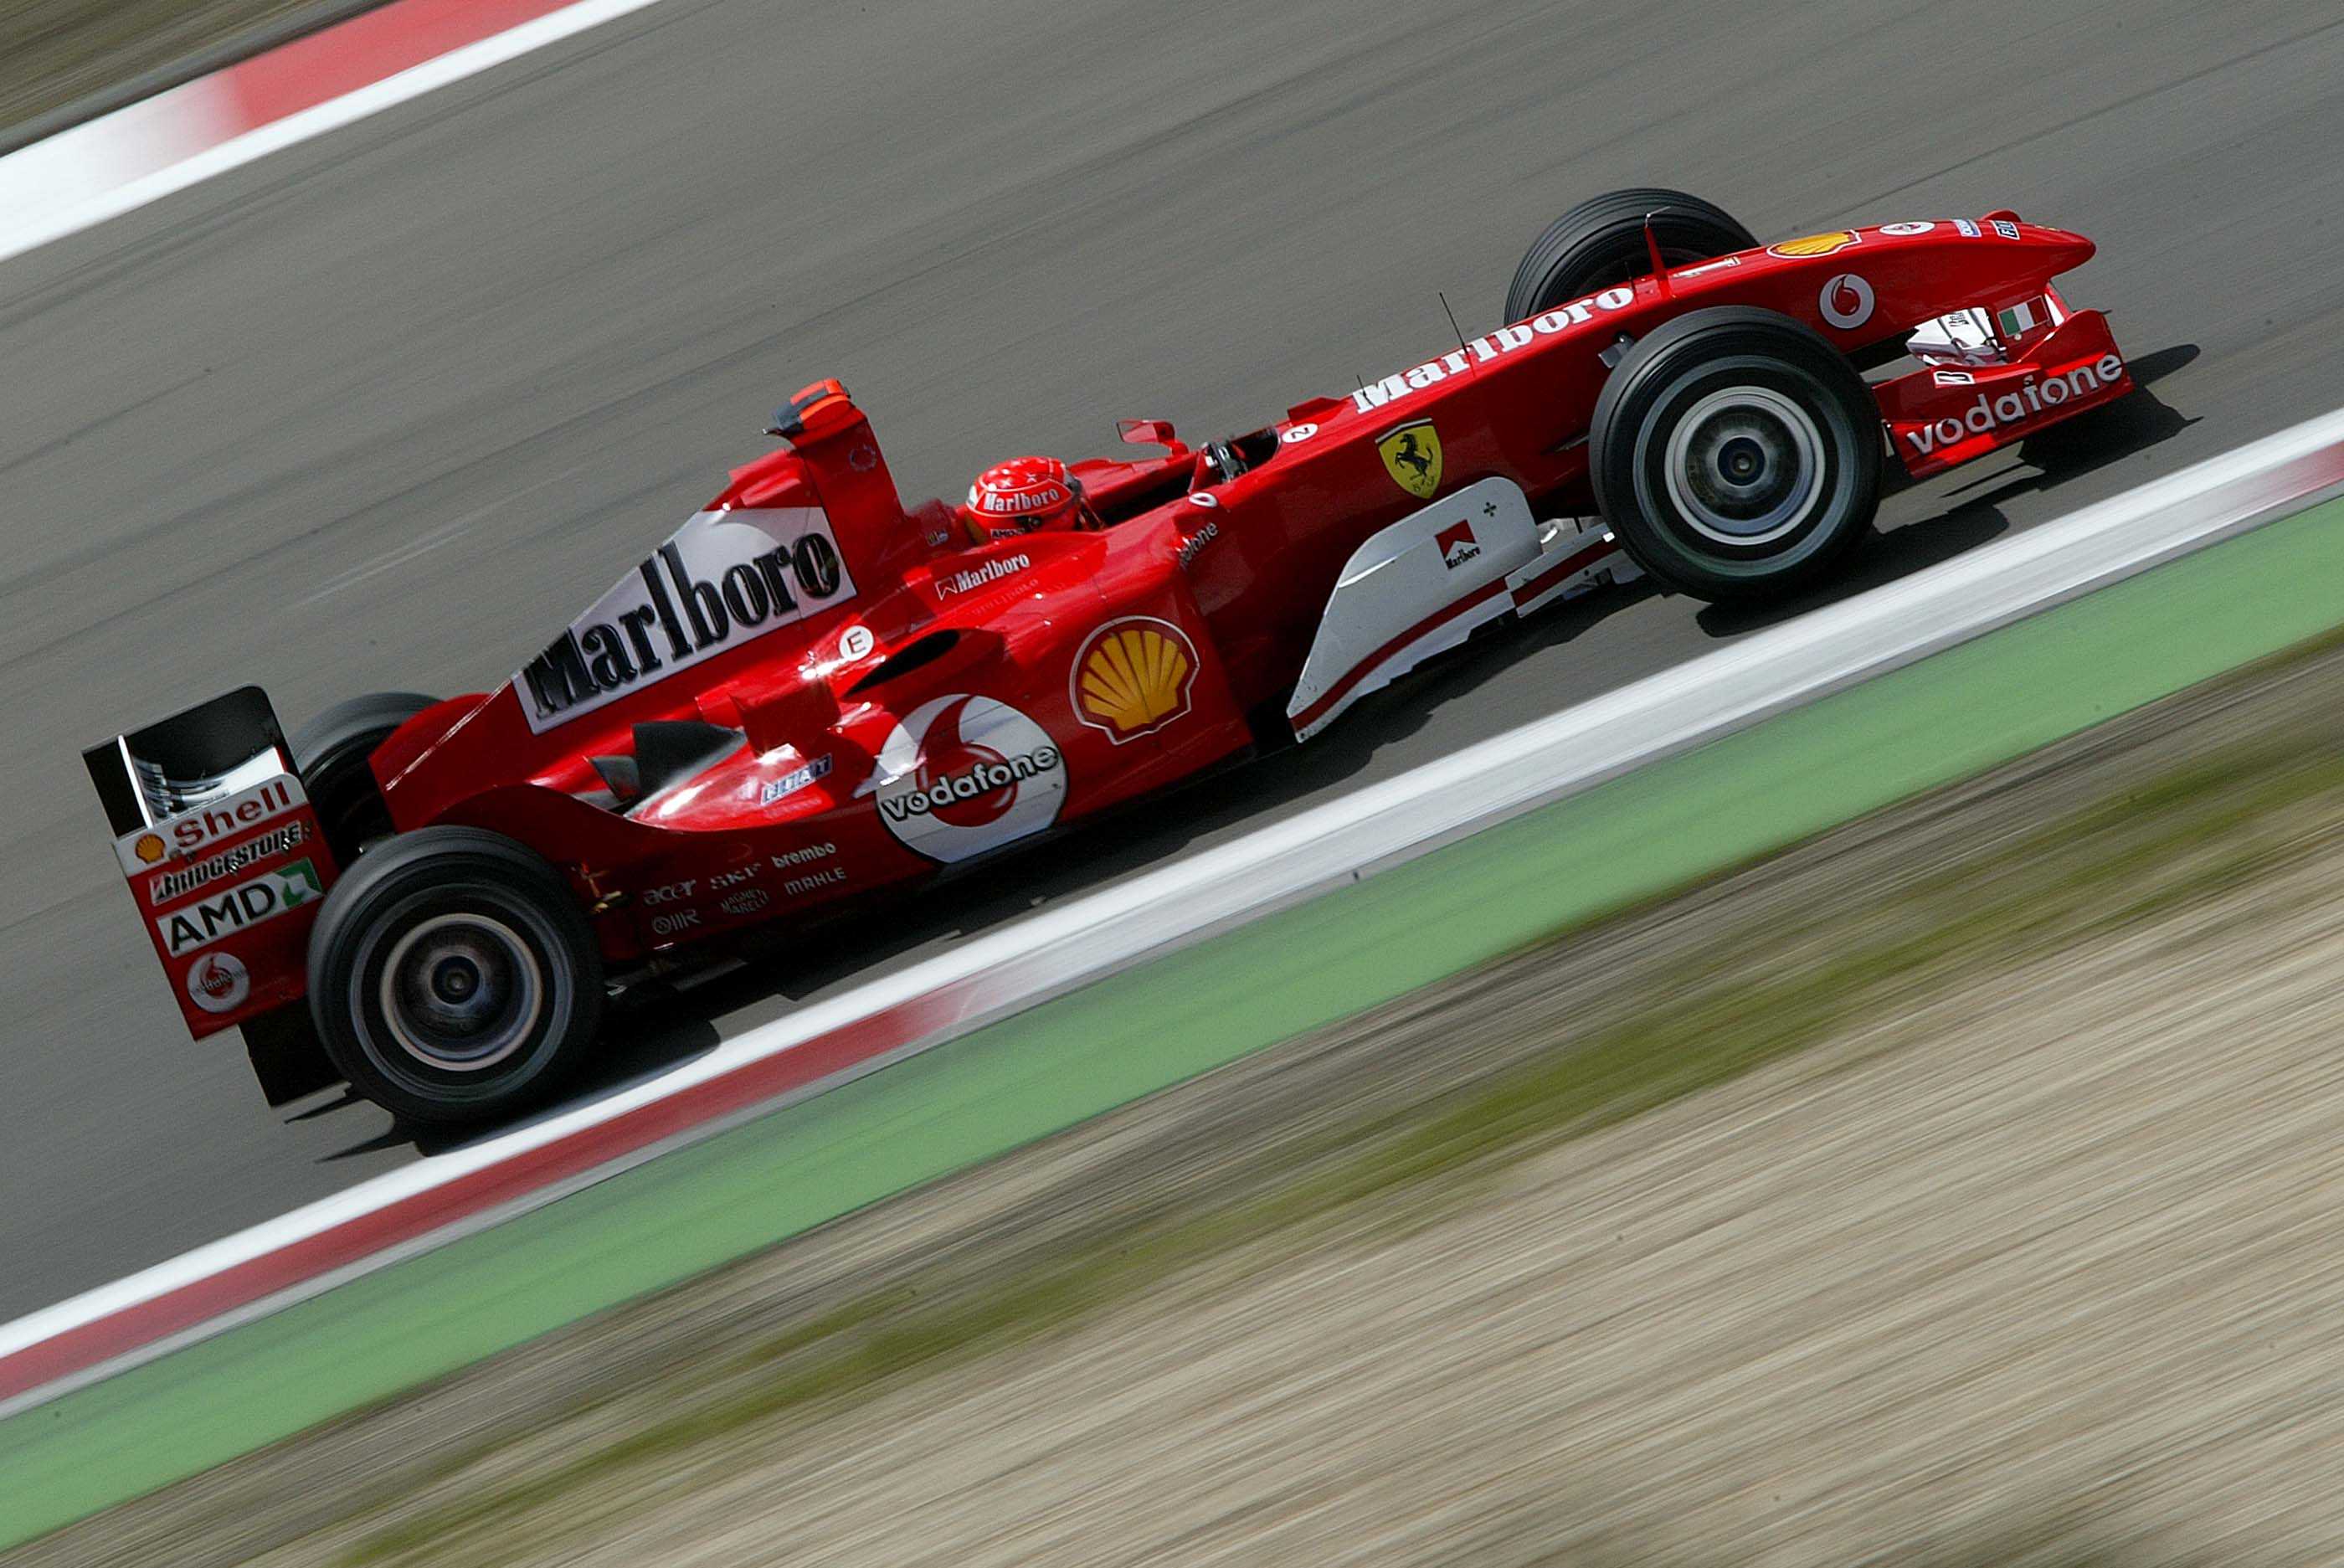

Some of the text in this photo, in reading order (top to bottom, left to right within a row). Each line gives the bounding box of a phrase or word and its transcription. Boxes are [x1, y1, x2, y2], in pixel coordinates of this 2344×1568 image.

[1352, 287, 1633, 414] Marlboro
[1907, 354, 2122, 455] vodafone
[984, 488, 1060, 512] Marlboro
[955, 553, 1031, 593] Marlboro
[1446, 547, 1480, 570] Marlboro
[522, 532, 840, 720] Marlboro
[847, 630, 867, 654] E
[882, 746, 1060, 820] vodafone
[173, 782, 290, 856] Shell
[644, 880, 697, 905] acer
[771, 842, 836, 868] brembo
[784, 866, 847, 896] MAHLE
[170, 883, 275, 951] AMD
